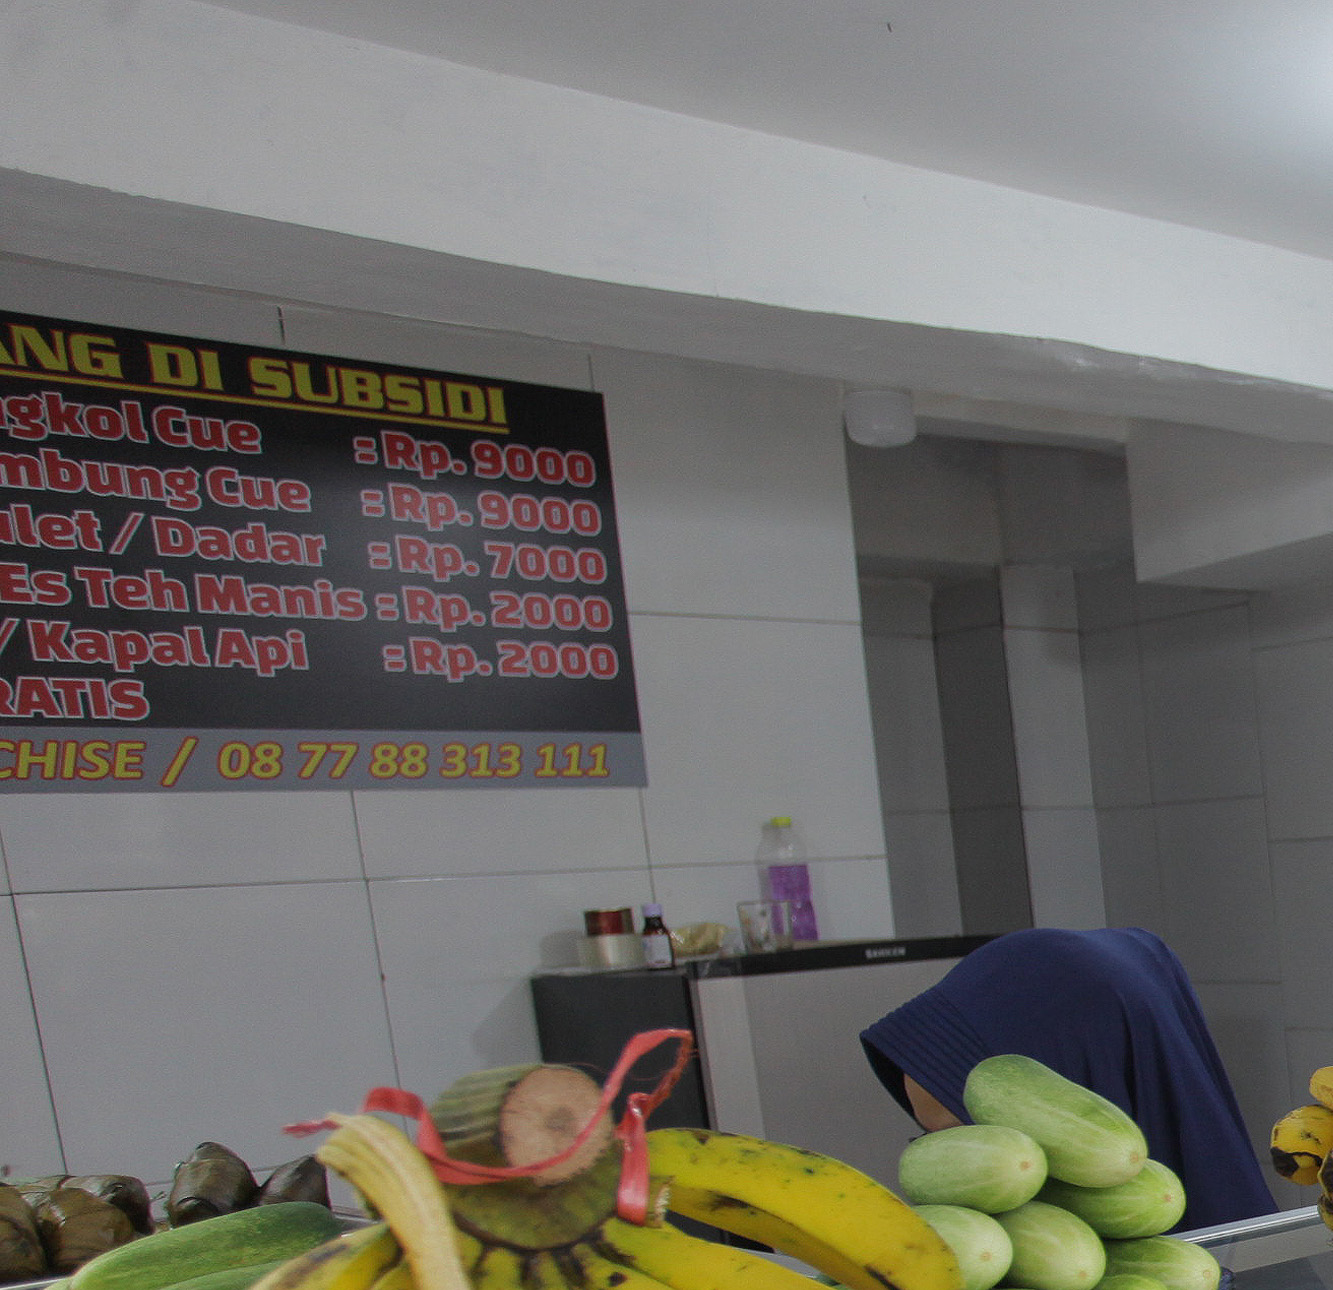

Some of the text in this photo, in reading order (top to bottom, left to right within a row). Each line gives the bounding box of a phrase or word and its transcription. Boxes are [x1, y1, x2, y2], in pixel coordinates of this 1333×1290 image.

[145, 341, 225, 392] DI
[248, 356, 508, 425] SUBSIDI
[152, 406, 262, 454] Cue
[470, 439, 597, 488] 9000
[204, 466, 312, 512] Cue
[477, 490, 602, 537] 9000
[151, 516, 326, 566] Dadar
[484, 540, 608, 584] 7000
[74, 566, 190, 613] Teh
[195, 574, 368, 621] Manis
[489, 589, 613, 632] 2000
[25, 619, 212, 673] Kapal
[214, 628, 310, 678] Api
[496, 638, 619, 680] 2000
[159, 736, 199, 788] /
[217, 741, 284, 780] 08
[297, 742, 359, 780] 77
[369, 741, 429, 780] 88
[439, 741, 522, 780] 313
[534, 742, 610, 780] 111
